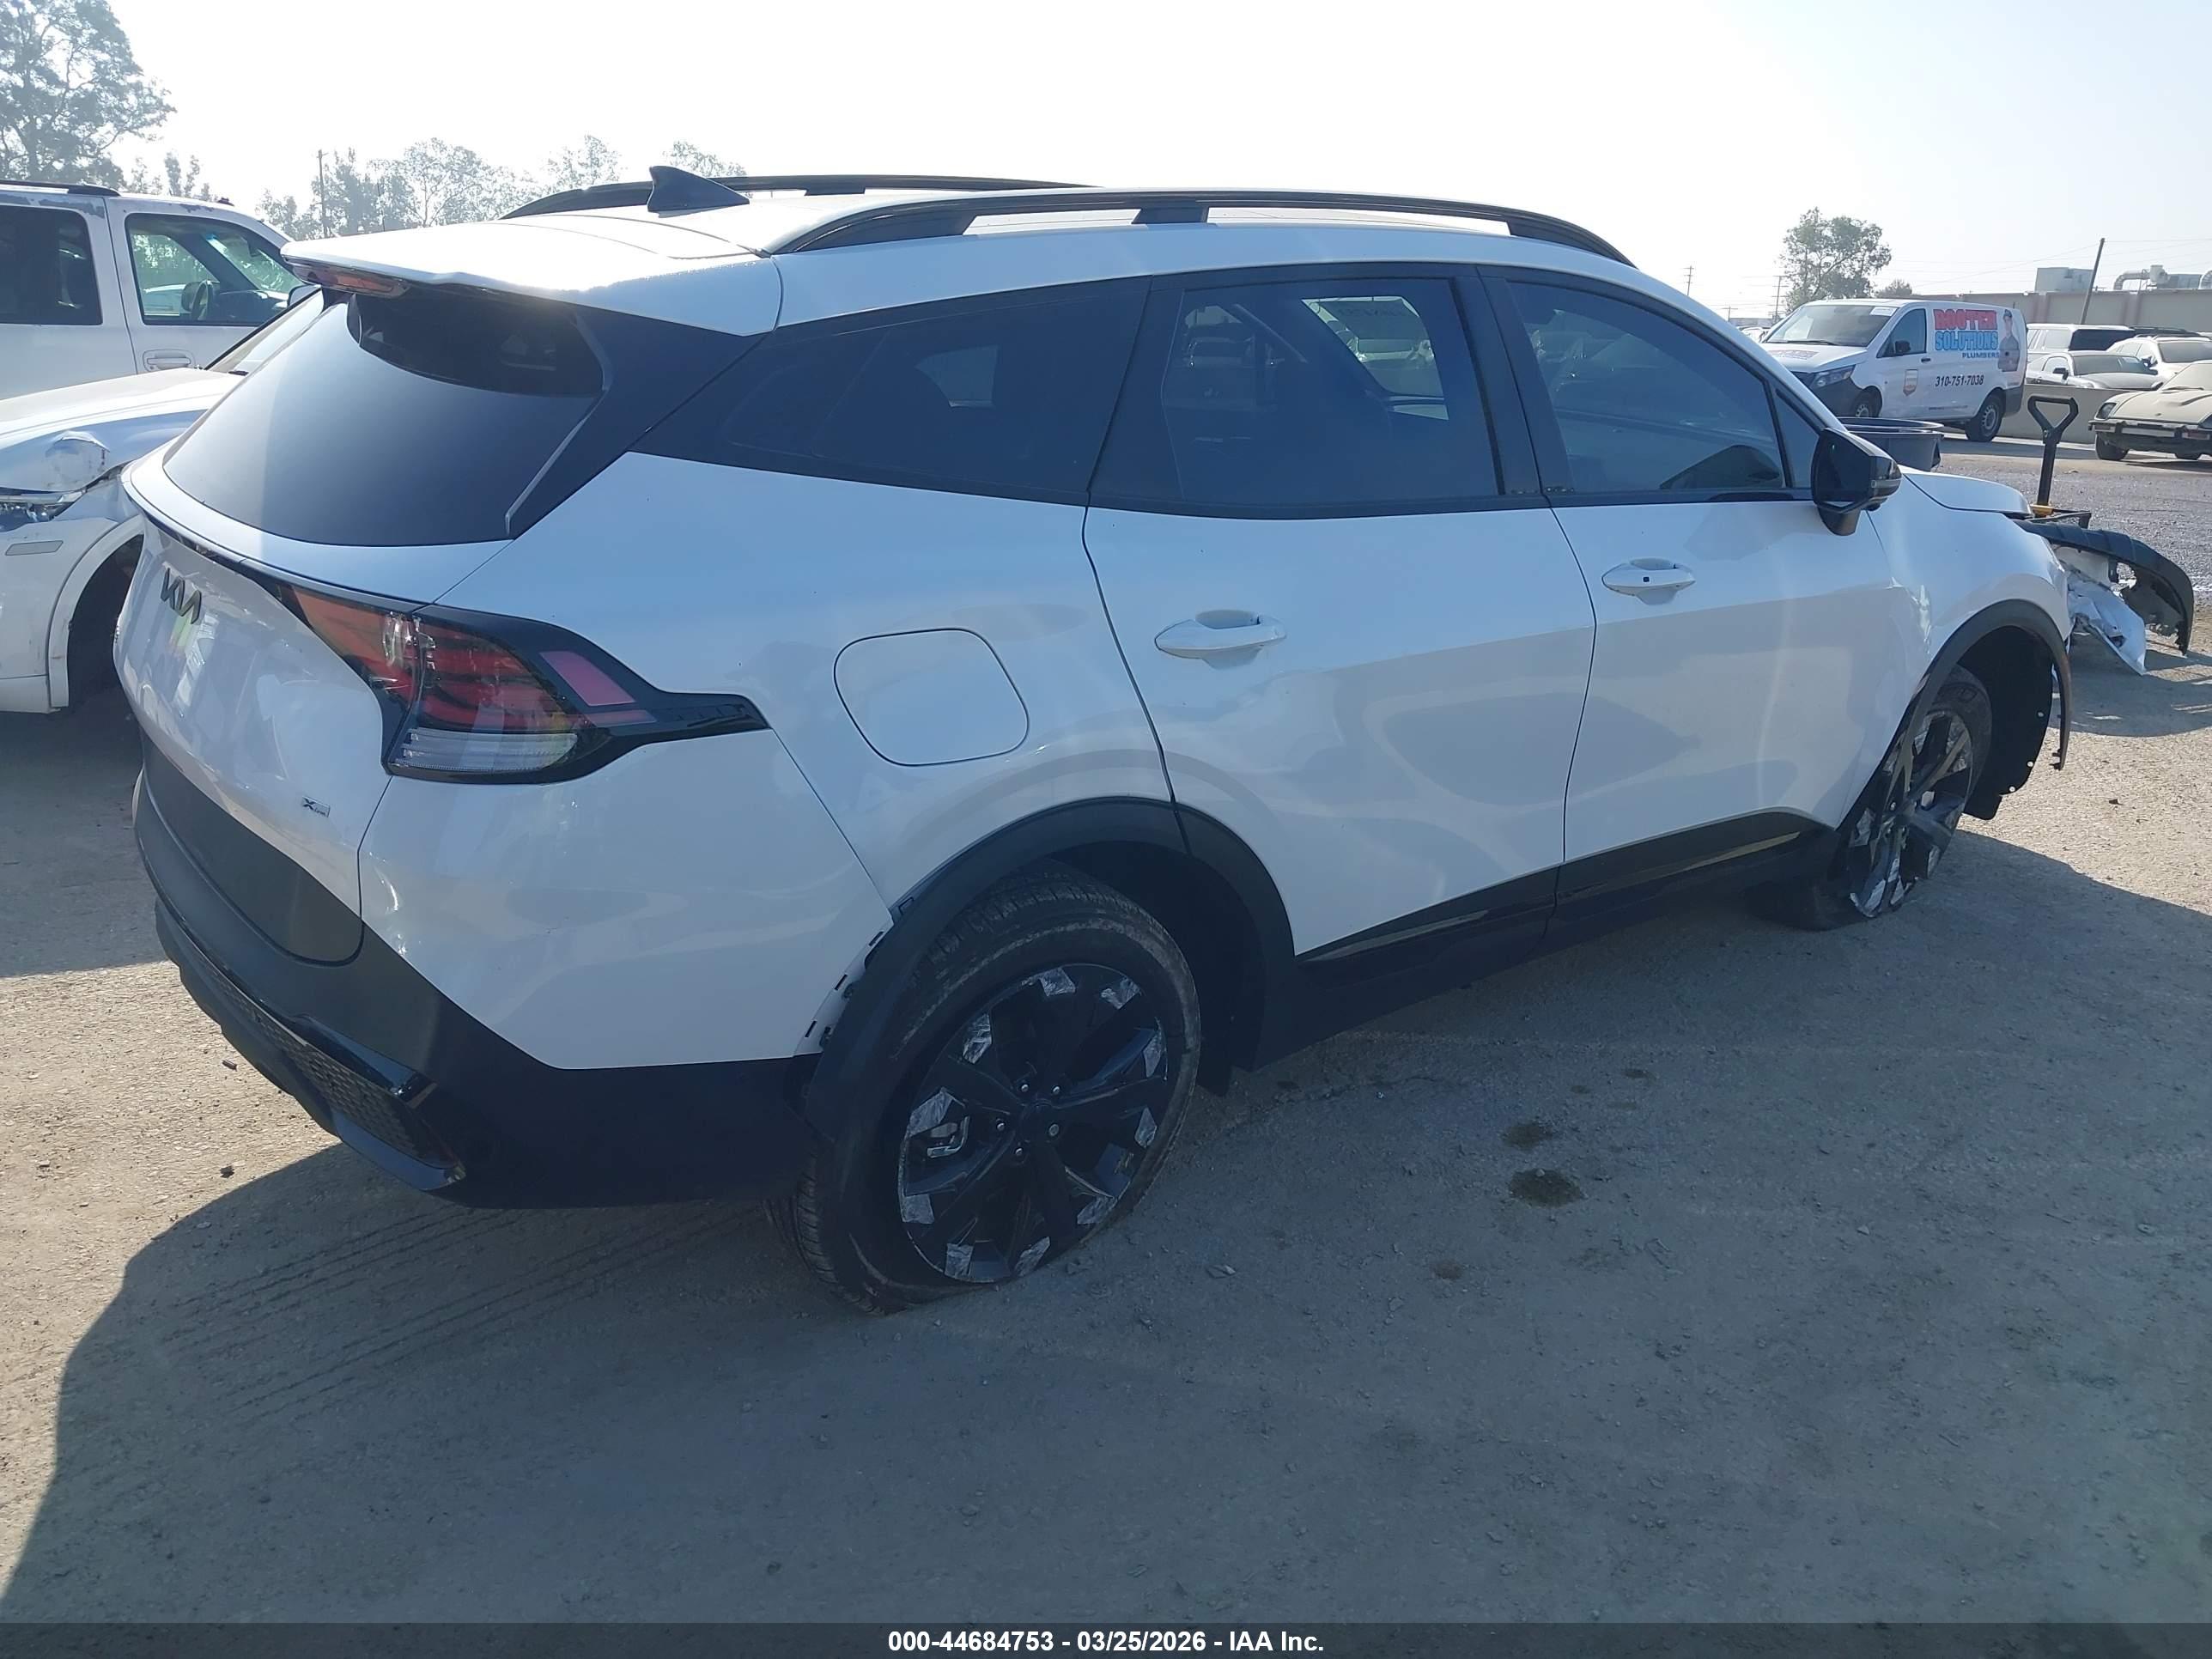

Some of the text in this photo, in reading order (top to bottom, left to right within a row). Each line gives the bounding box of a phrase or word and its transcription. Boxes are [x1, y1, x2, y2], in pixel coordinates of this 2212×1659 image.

[1935, 331, 1998, 350] SOLUTIONS
[1935, 374, 1984, 386] 310-751-7038
[161, 568, 202, 624] KIA
